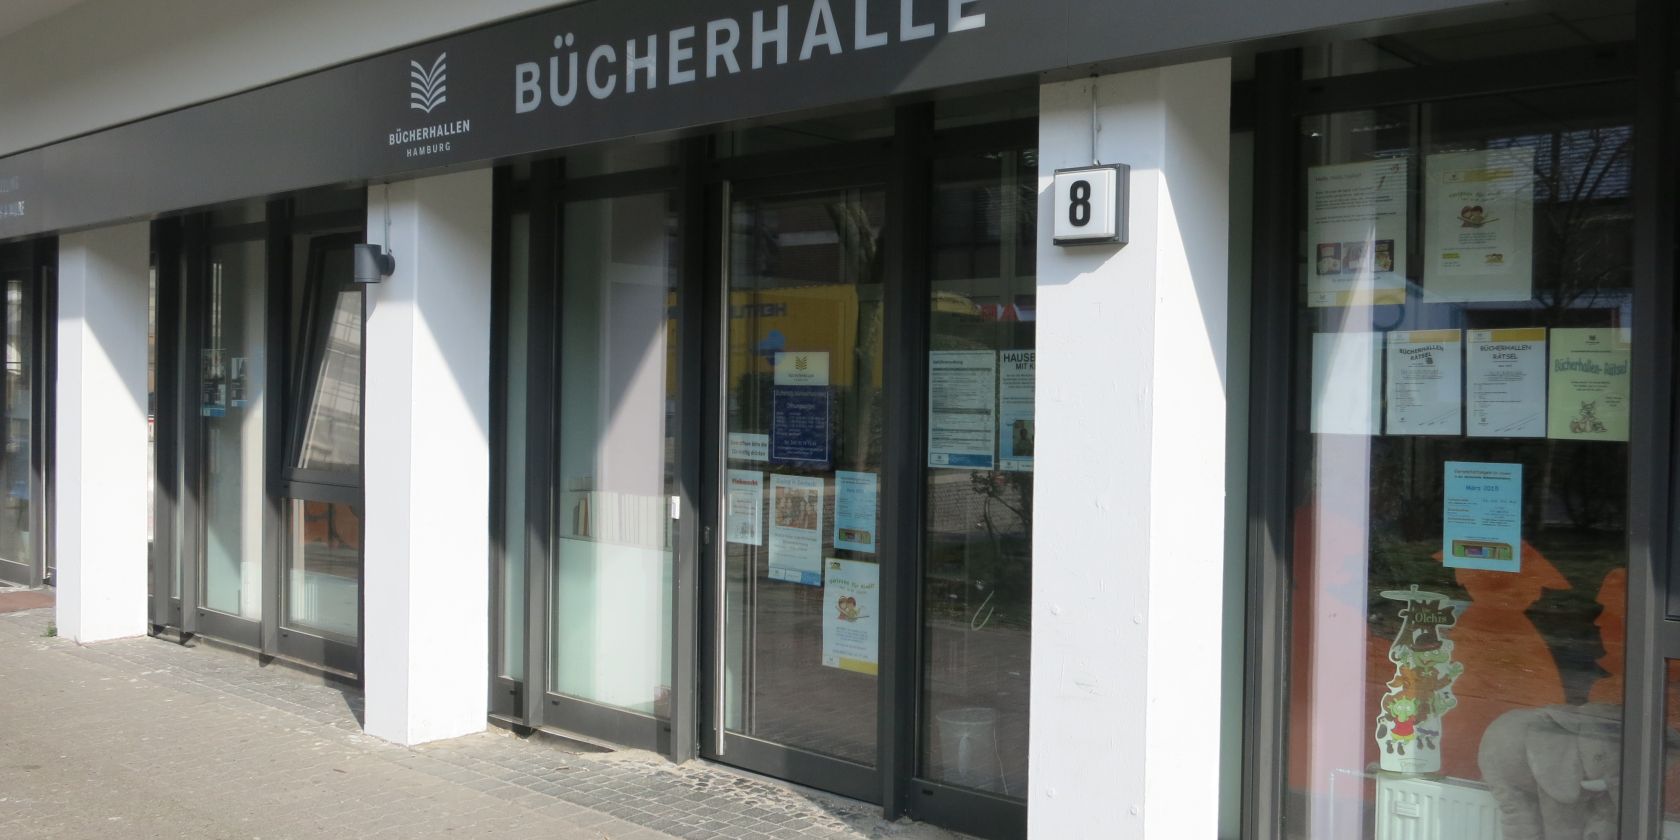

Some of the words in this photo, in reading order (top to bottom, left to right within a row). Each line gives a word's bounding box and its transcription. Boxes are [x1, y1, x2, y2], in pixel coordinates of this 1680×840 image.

[388, 120, 470, 146] BÜCHERHALLEN
[406, 142, 451, 157] HAMBURG
[1069, 180, 1091, 227] 8
[1399, 344, 1444, 355] BÜCHERHALLEN
[1480, 344, 1532, 352] BÜCHERHALLEN
[1492, 352, 1518, 360] RÄTSEL
[1415, 612, 1447, 623] Olchis
